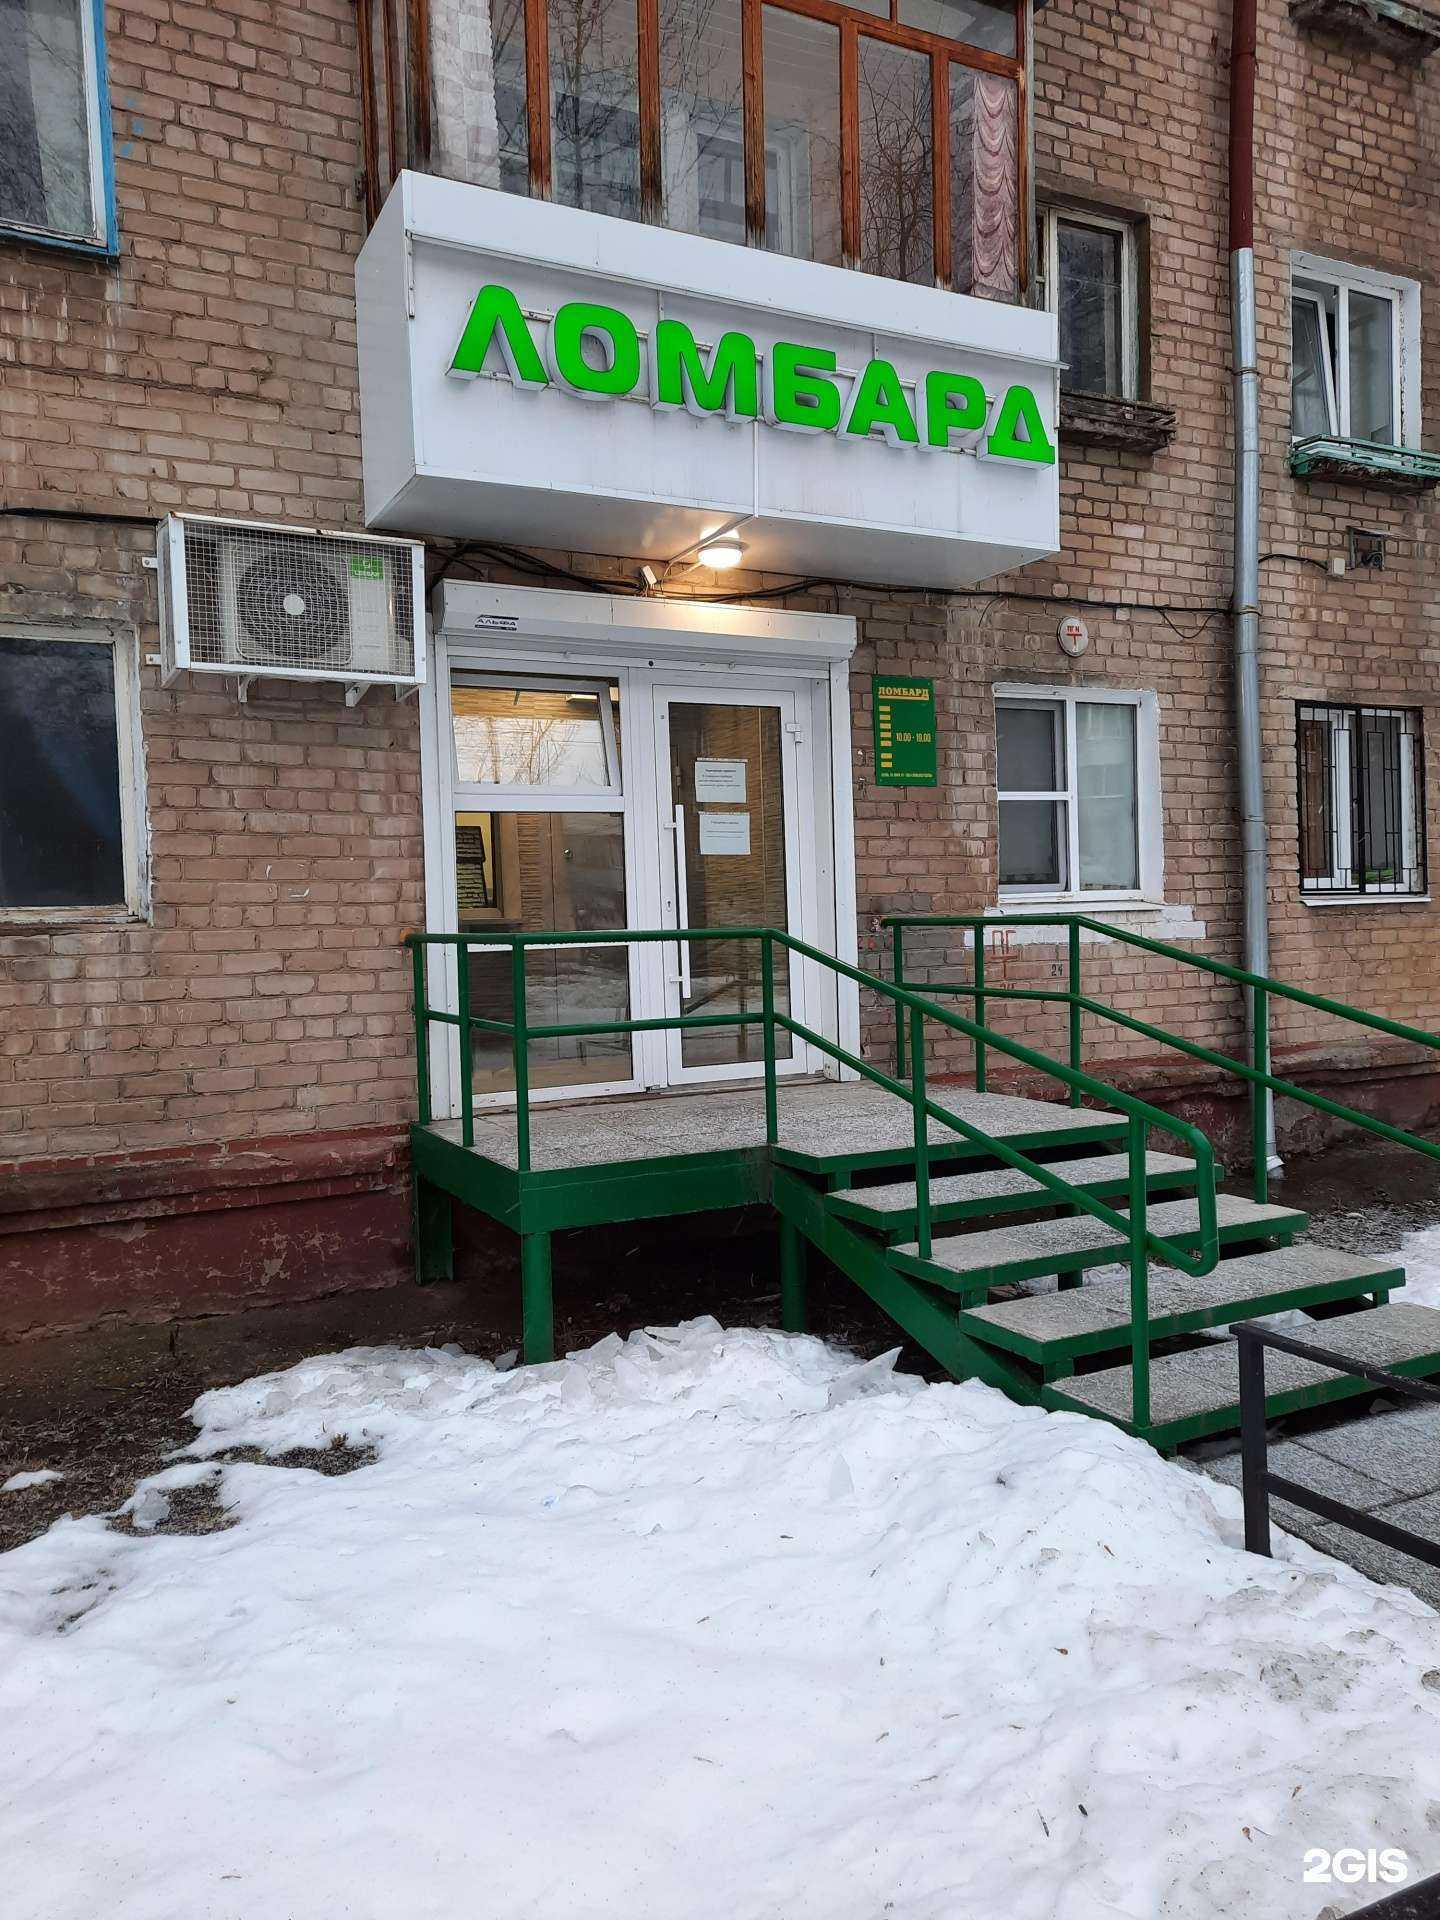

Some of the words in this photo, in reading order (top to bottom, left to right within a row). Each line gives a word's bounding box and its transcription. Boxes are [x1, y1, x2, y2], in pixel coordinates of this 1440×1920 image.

[449, 284, 1055, 466] ЛОМБАРД
[477, 618, 516, 626] АЛЬФА
[878, 687, 929, 698] ЛОМБАРД
